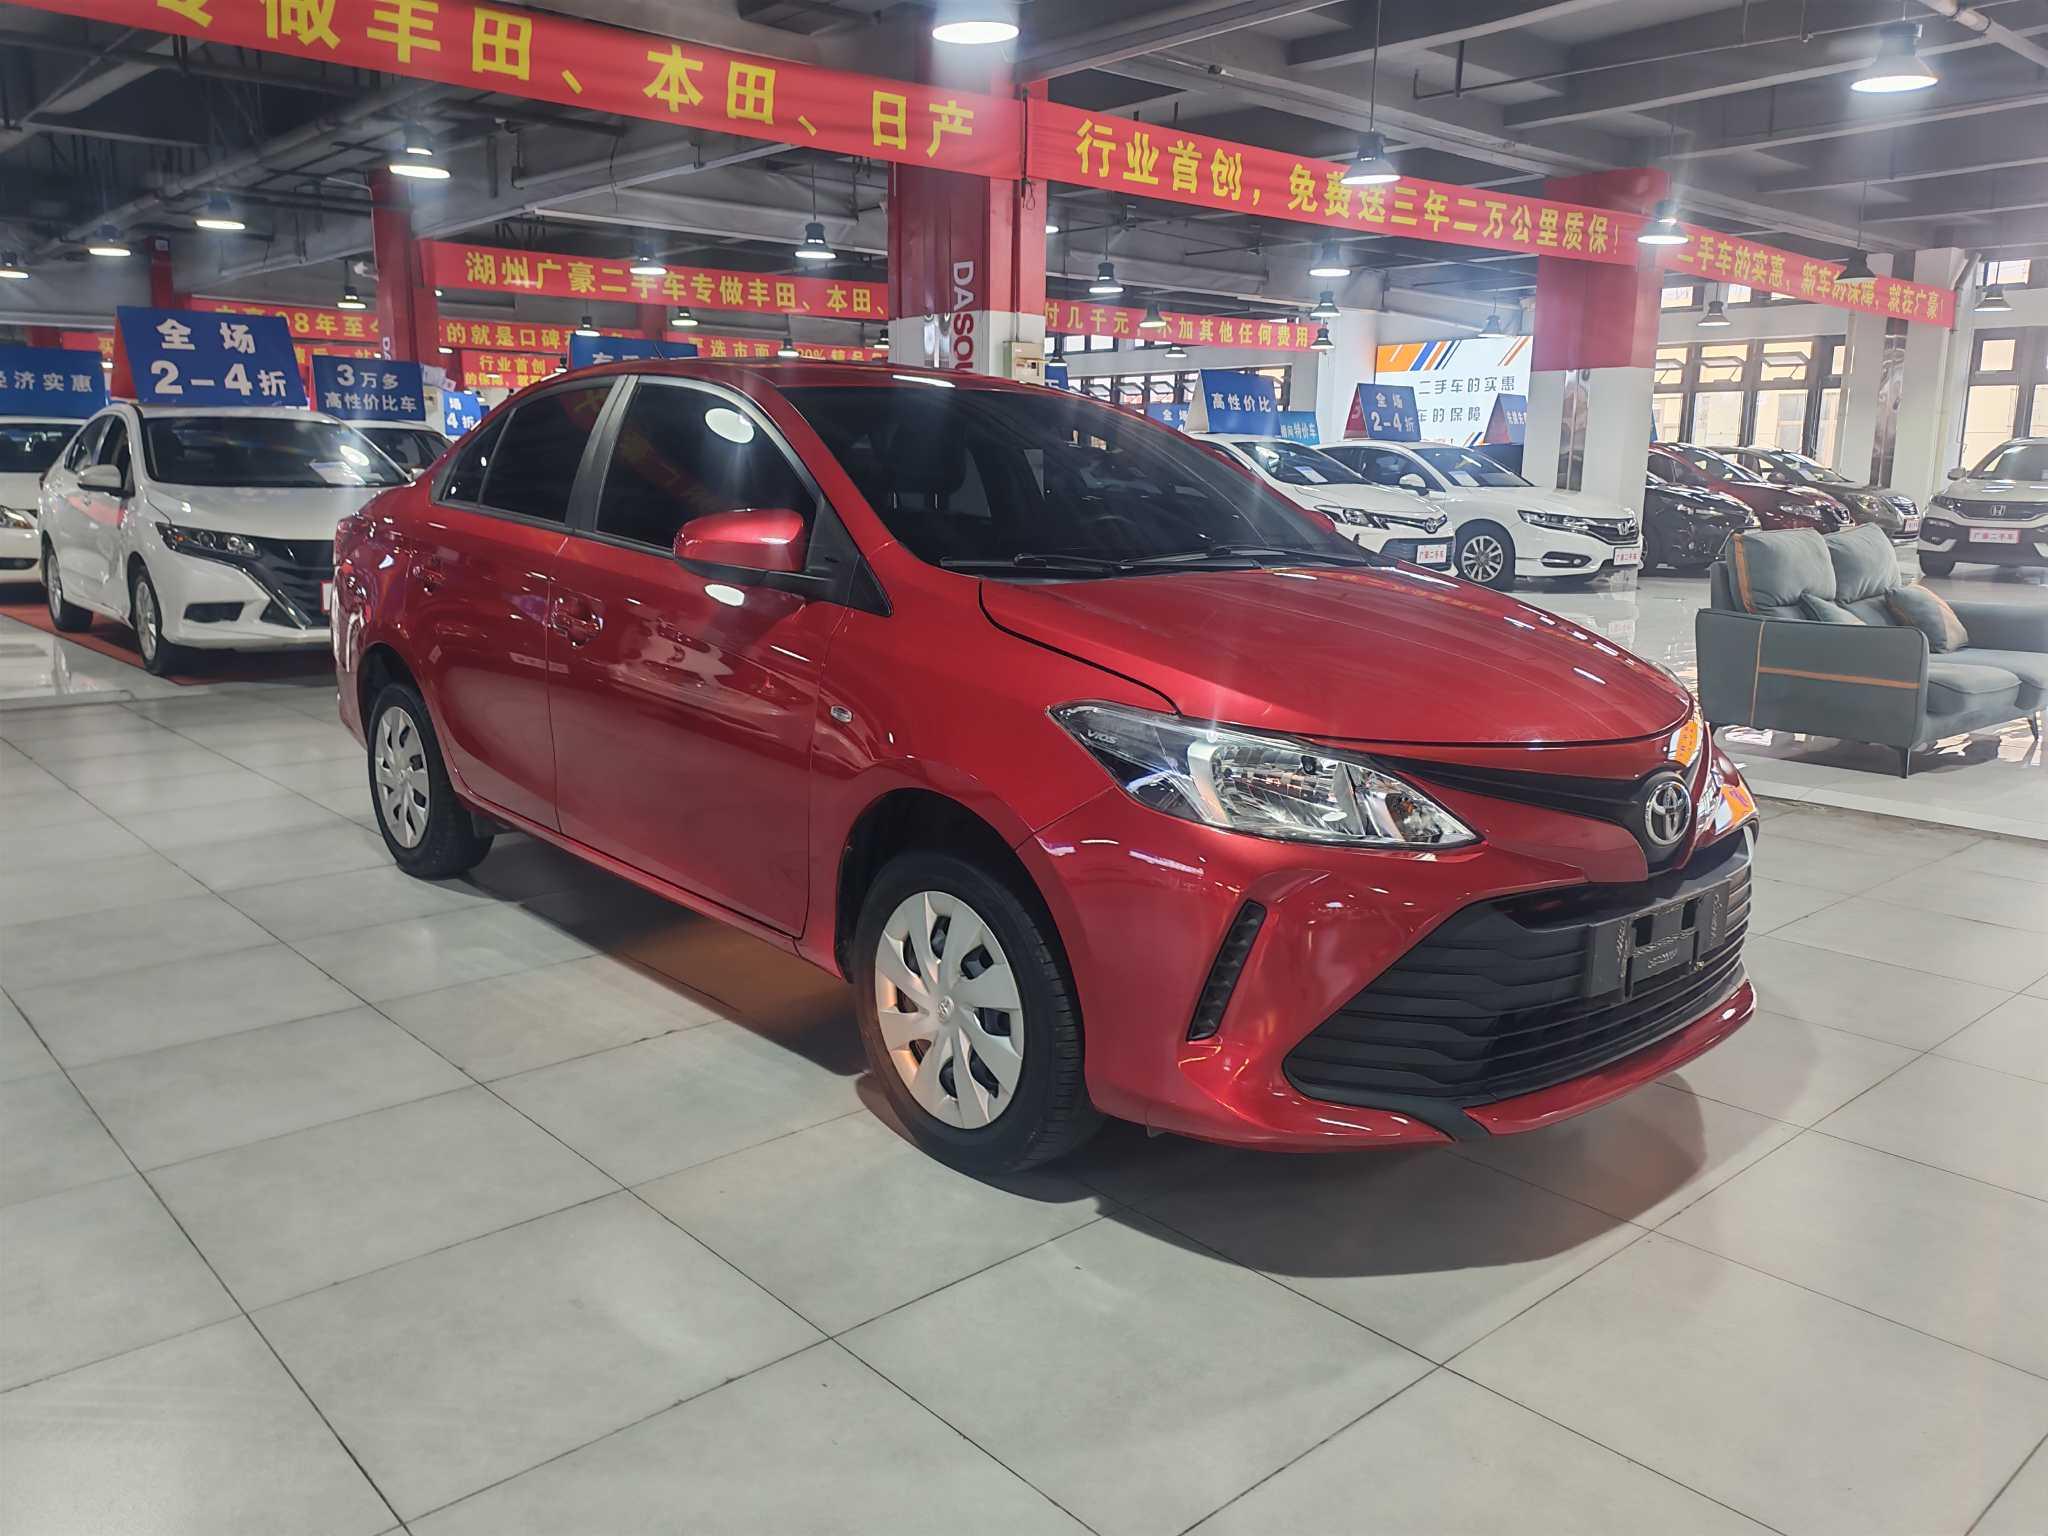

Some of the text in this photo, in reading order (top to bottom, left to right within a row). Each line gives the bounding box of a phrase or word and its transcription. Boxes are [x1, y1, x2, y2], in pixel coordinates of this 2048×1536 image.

[156, 318, 257, 354] 全场
[336, 364, 399, 390] 3万多
[1418, 375, 1516, 395] 二手车的实惠
[325, 391, 417, 413] 高性价比车
[1210, 392, 1273, 412] 高性价比
[1375, 392, 1403, 409] 全场
